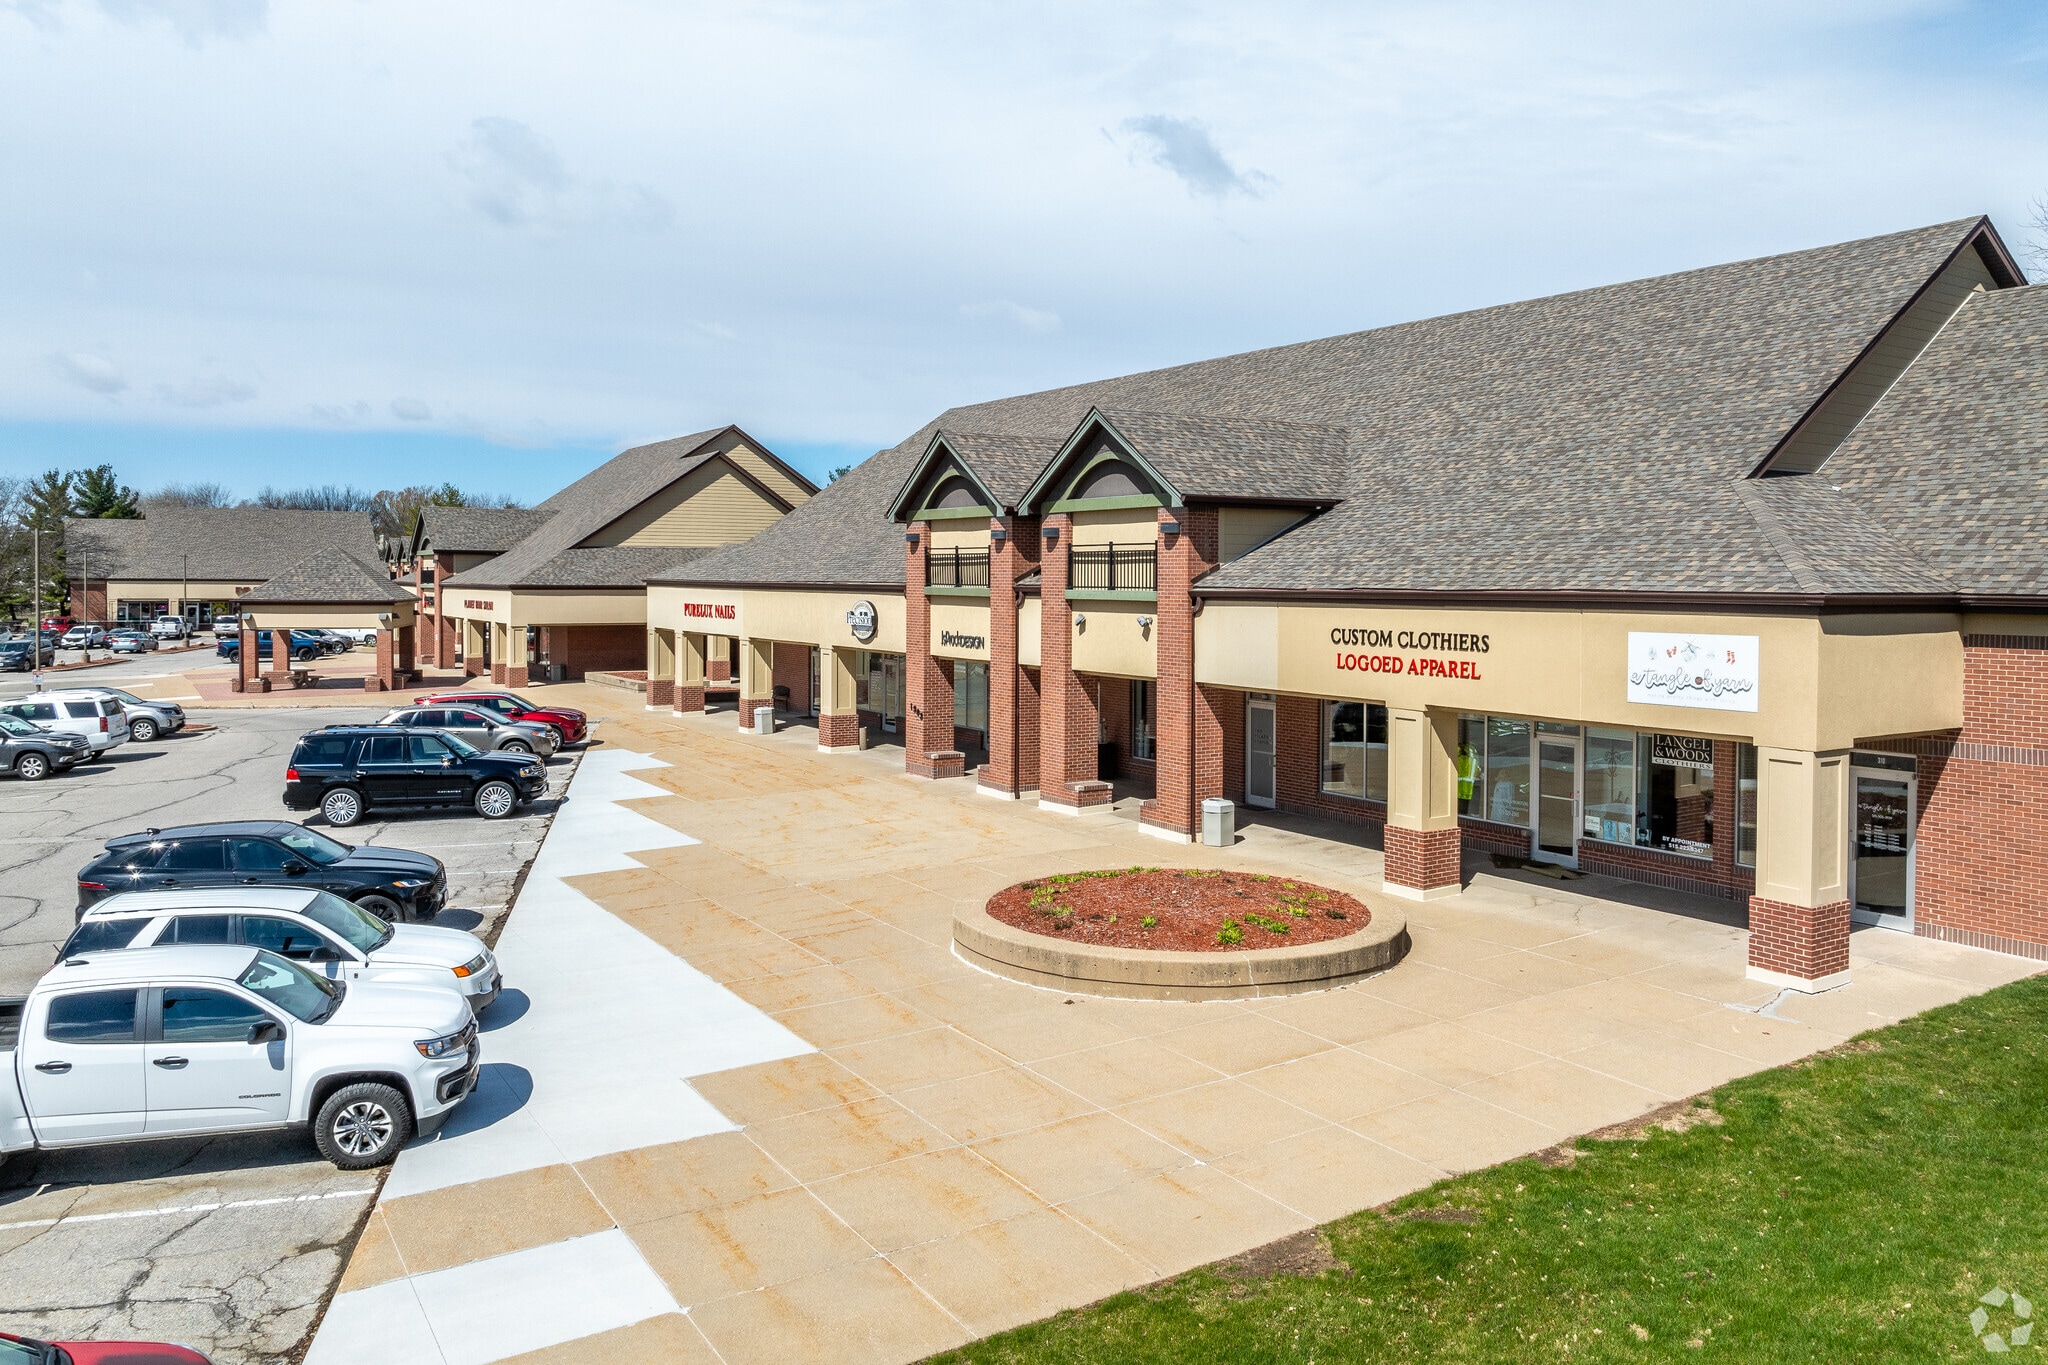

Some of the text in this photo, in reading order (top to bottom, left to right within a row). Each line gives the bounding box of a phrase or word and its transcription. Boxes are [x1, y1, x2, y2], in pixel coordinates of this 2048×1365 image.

[683, 603, 736, 620] PURELUX NAILS
[1330, 627, 1490, 653] CUSTOM CLOTHIERS
[1336, 652, 1481, 680] LOGOED APPAREL
[1643, 667, 1691, 694] tangle
[1713, 677, 1753, 697] yarn
[1656, 735, 1710, 751] LANGEL
[1655, 746, 1710, 762] & WOODS
[1655, 759, 1711, 769] CLOTHIERS
[1671, 837, 1711, 849] APPOINTMENT
